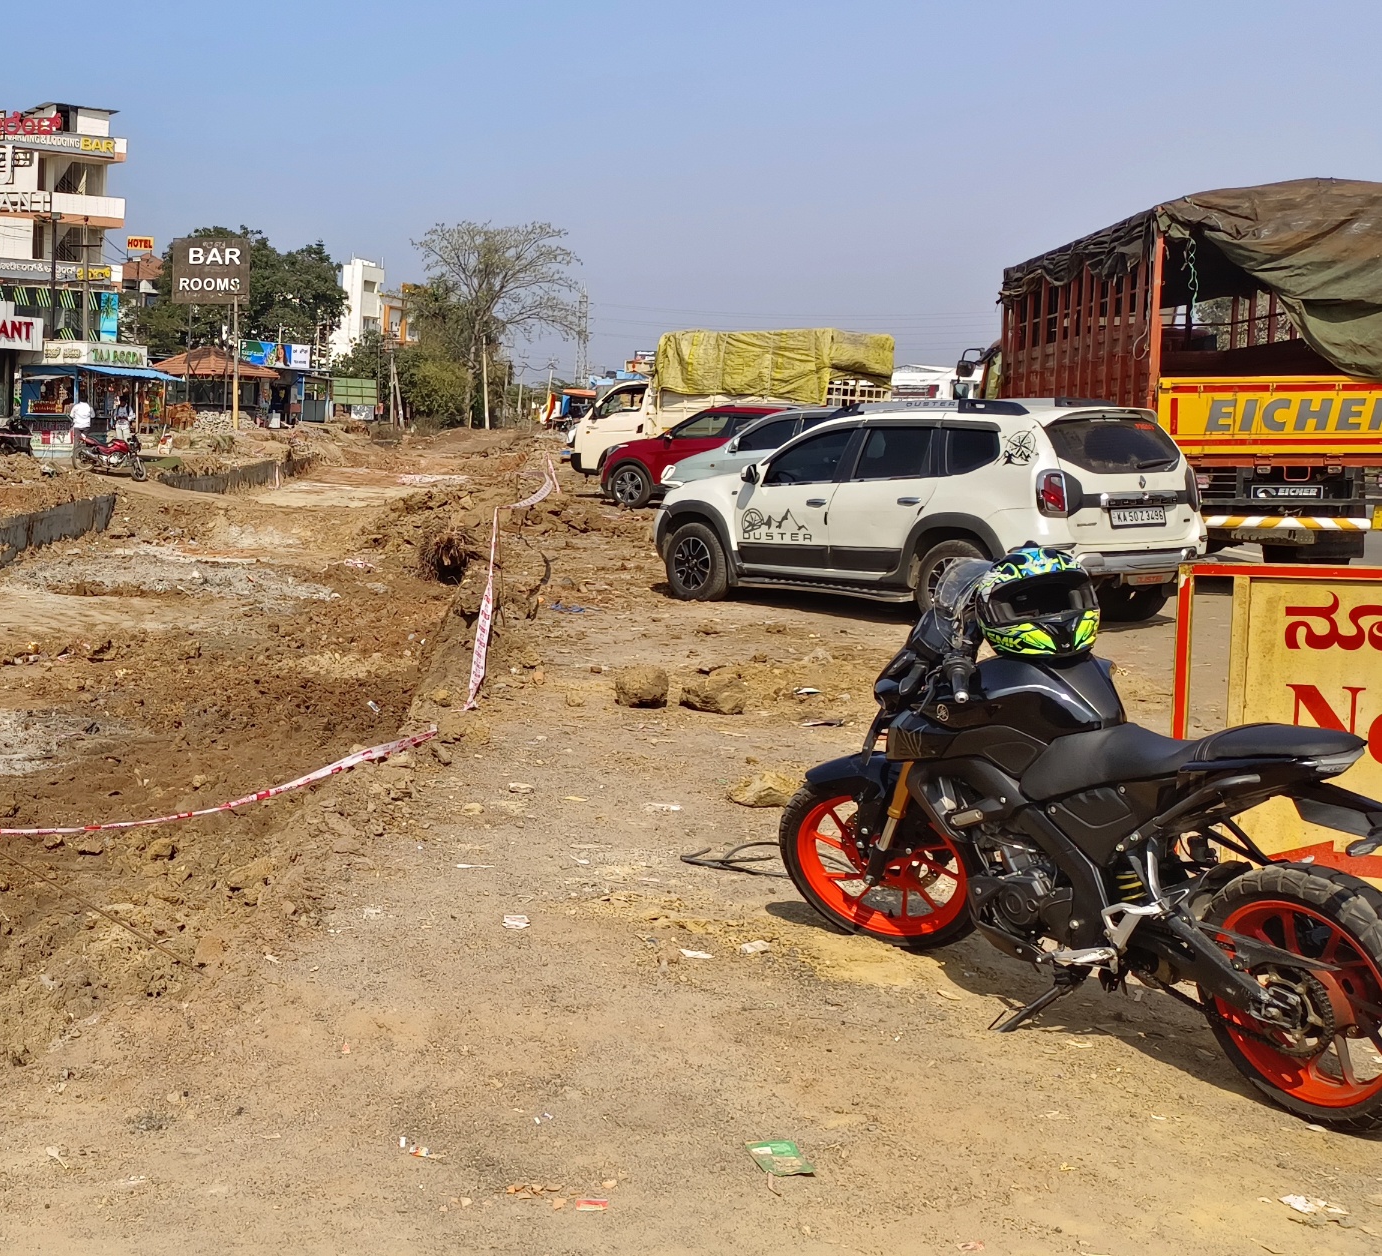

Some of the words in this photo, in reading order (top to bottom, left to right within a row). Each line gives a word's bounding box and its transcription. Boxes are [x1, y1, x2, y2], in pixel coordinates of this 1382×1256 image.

[80, 136, 115, 153] BAR
[127, 238, 153, 249] HOTEL
[188, 247, 241, 266] BAR
[179, 277, 240, 291] ROOMS
[93, 348, 110, 362] TAJ
[1277, 487, 1318, 497] EICHER
[1117, 511, 1127, 522] KA
[1129, 511, 1138, 521] 50
[743, 531, 812, 542] DUSTER
[987, 631, 1022, 649] SMK
[1286, 684, 1382, 764] N
